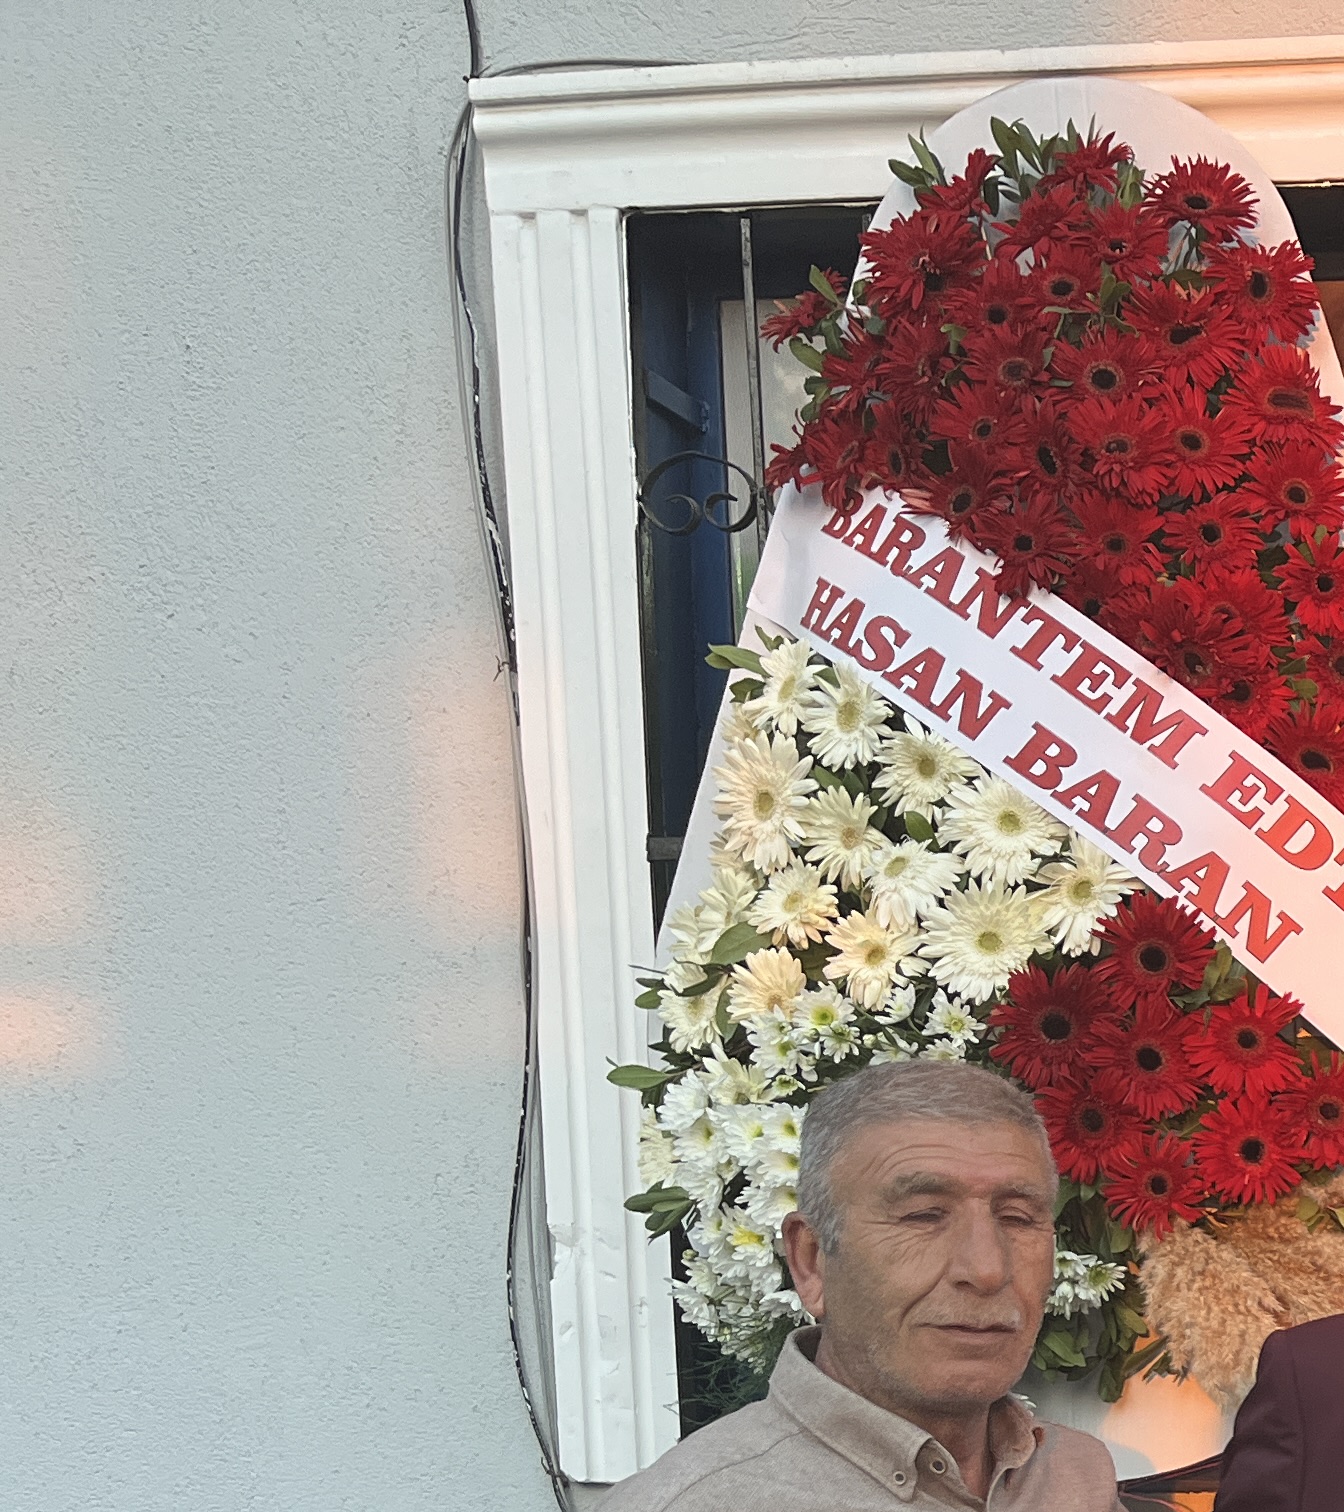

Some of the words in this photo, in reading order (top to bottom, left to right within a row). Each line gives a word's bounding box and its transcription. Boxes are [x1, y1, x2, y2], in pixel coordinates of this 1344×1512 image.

[800, 576, 1013, 740] HASAN
[1002, 721, 1304, 963] BARAN
[821, 489, 1209, 769] BARANTEM
